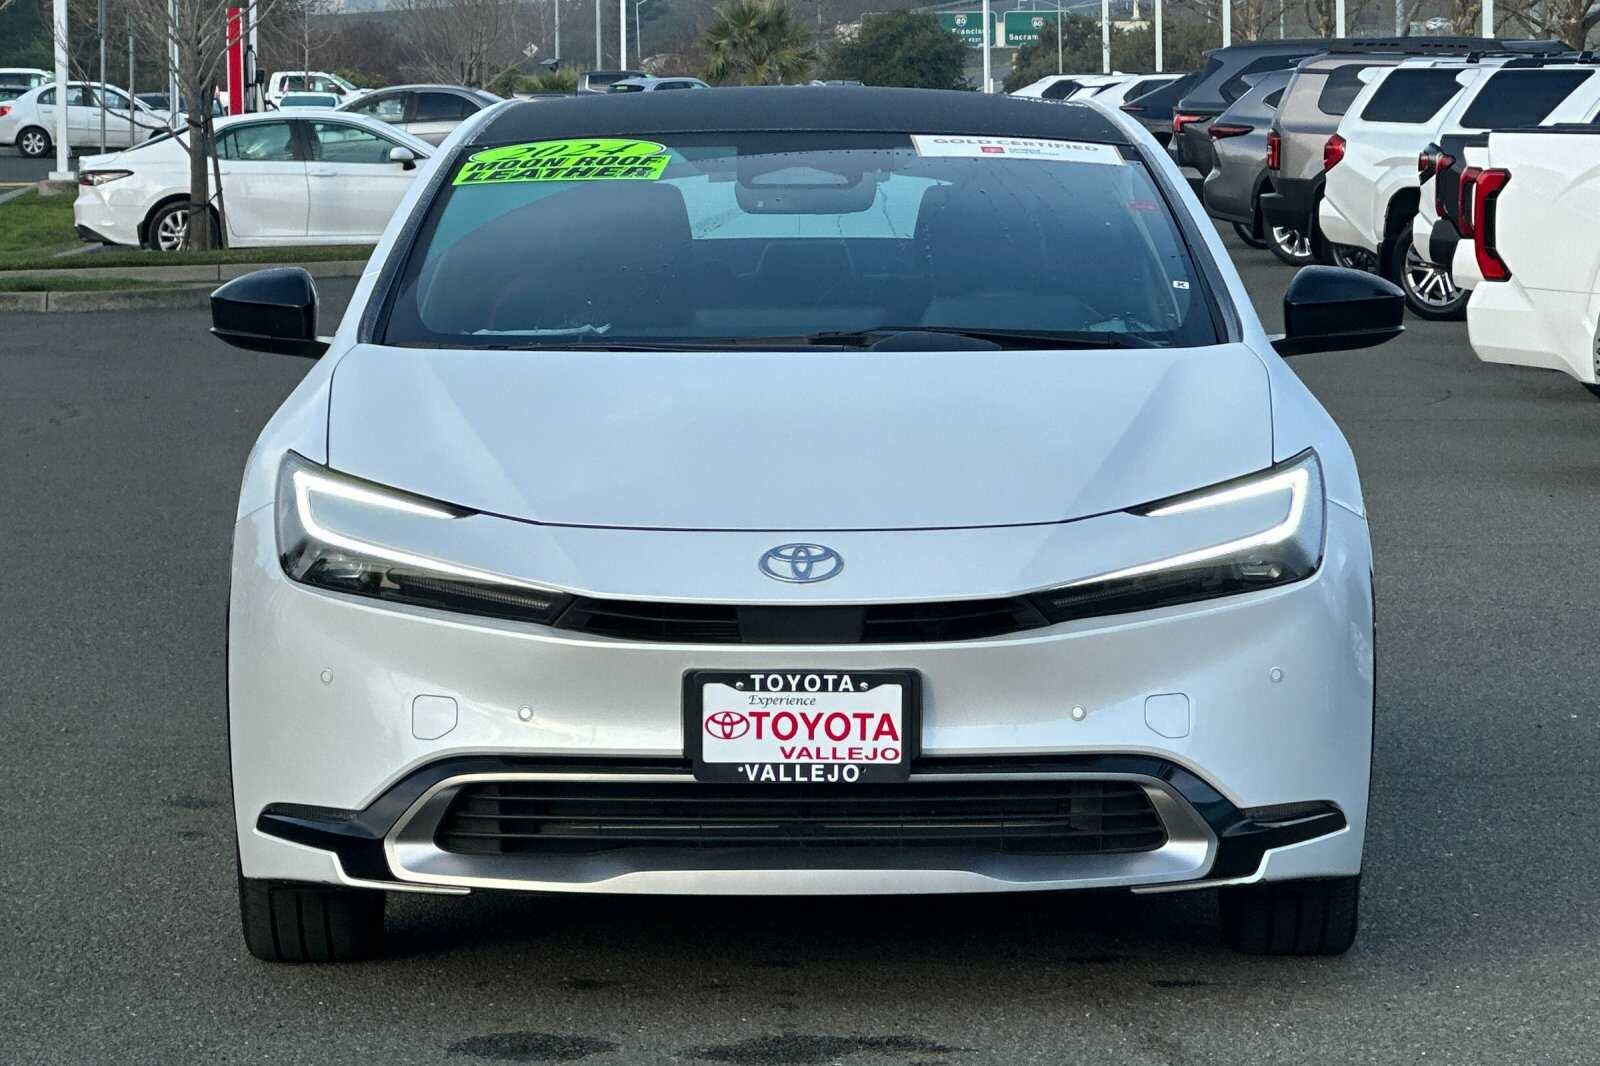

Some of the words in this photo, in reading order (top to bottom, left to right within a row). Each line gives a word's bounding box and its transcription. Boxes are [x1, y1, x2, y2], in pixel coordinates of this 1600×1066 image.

[496, 142, 639, 160] 2024
[997, 139, 1099, 152] CERTIFIED
[465, 157, 566, 171] MOON
[572, 155, 665, 166] ROOF
[461, 166, 656, 182] LEATHER
[750, 674, 855, 692] TOYOTA
[748, 694, 817, 708] Experience
[749, 711, 900, 742] TOYOTA
[779, 746, 900, 761] VALLEJO
[745, 764, 860, 782] VALLEJO
